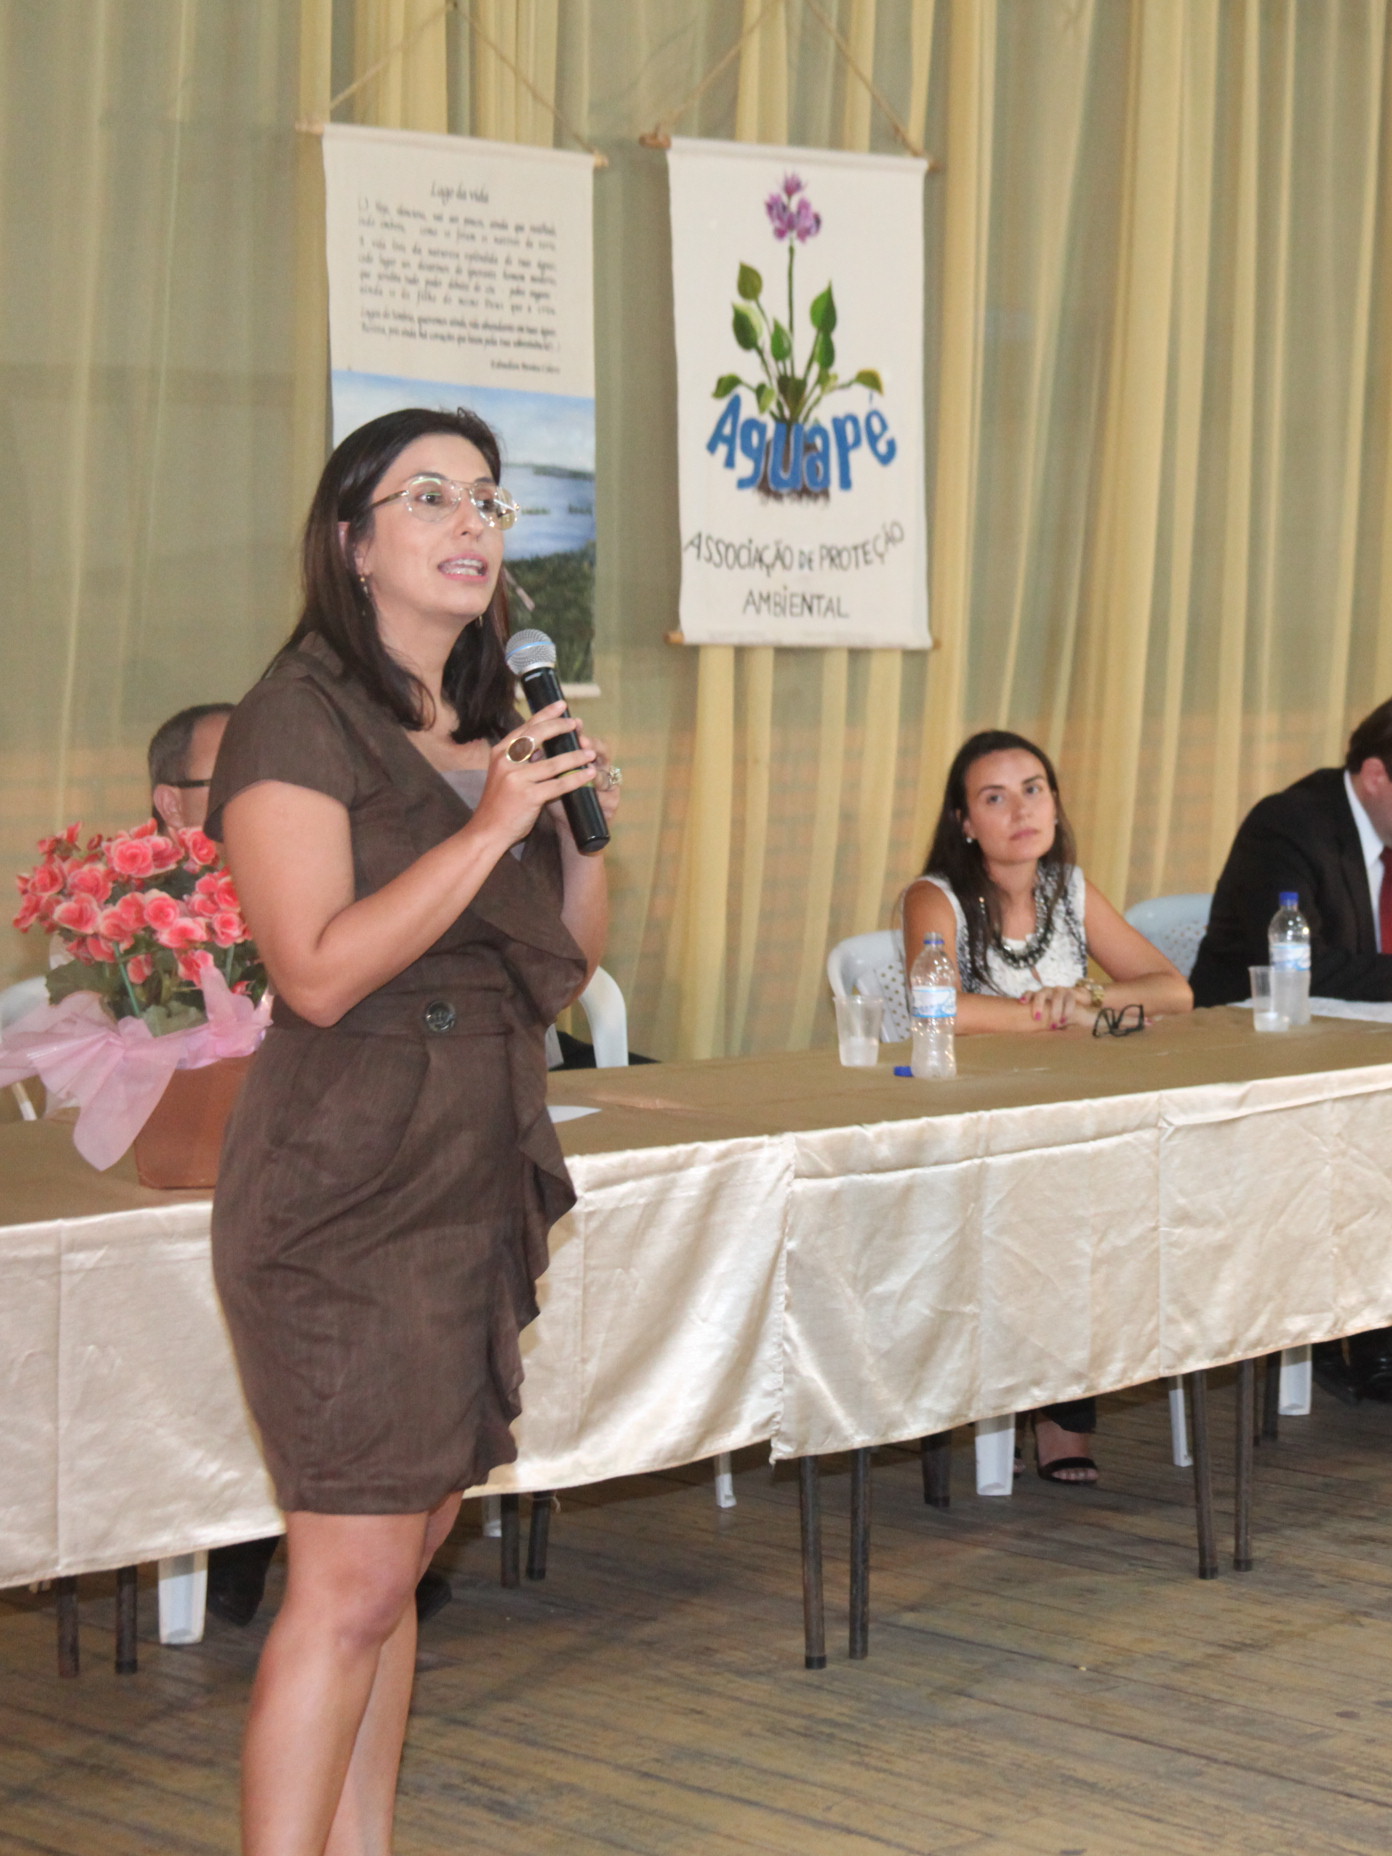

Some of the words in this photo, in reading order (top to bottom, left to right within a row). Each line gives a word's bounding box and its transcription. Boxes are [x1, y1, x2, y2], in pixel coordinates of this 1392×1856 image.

[456, 181, 467, 201] da
[469, 183, 489, 204] vida
[684, 531, 794, 577] ASSOCIAÇÃO
[798, 549, 815, 571] DE
[819, 520, 905, 571] PROTEÇÃO
[743, 585, 849, 619] AMBIENTAL
